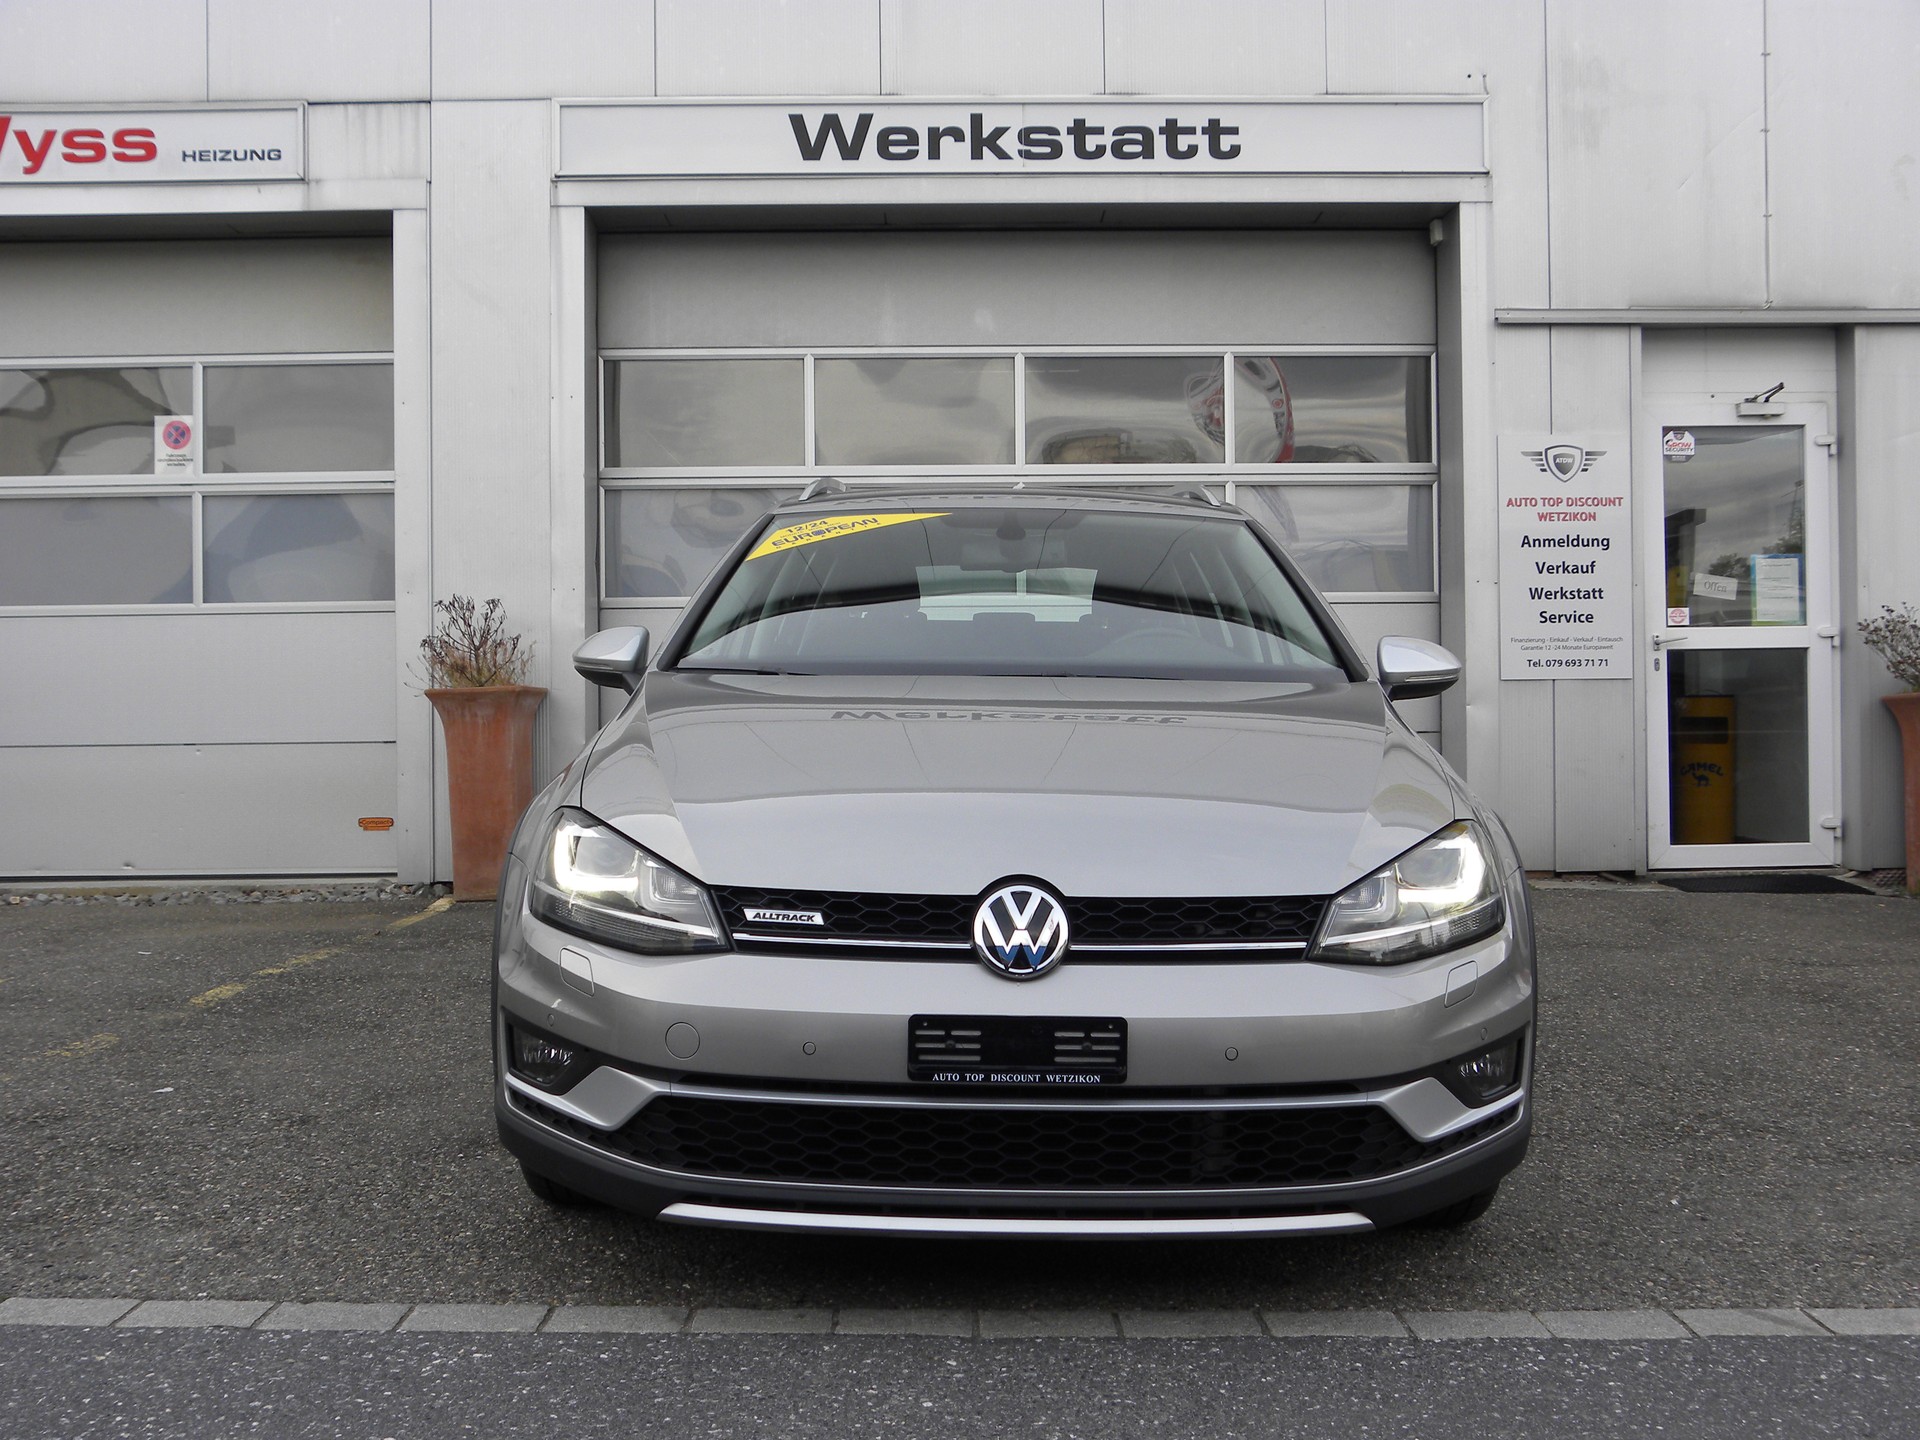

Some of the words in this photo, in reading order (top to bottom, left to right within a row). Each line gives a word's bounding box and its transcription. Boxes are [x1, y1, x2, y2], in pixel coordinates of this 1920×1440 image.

[787, 112, 1242, 161] Werkstatt
[0, 115, 157, 175] yss
[181, 148, 282, 163] HEIZUNG
[1506, 497, 1538, 508] AUTO
[1540, 497, 1563, 507] TOP
[1566, 496, 1624, 507] DISCOUNT
[1537, 511, 1597, 522] WETZIKON
[786, 520, 828, 533] 12/24
[1520, 534, 1611, 551] Anmeldung
[1535, 560, 1597, 575] Verkauf
[1528, 586, 1605, 601] Werkstatt
[1539, 610, 1595, 624] Service
[1526, 659, 1544, 668] Tel.
[1545, 659, 1563, 668] 079
[1564, 659, 1582, 667] 693
[1584, 659, 1595, 667] 71
[1597, 659, 1609, 667] 71
[1680, 762, 1723, 776] CAMEL
[752, 912, 816, 923] ALLTRACK
[932, 1073, 960, 1082] AUTO
[965, 1073, 985, 1082] TOP
[990, 1074, 1041, 1083] DISCOUNT
[1046, 1075, 1101, 1084] WETZIKON
